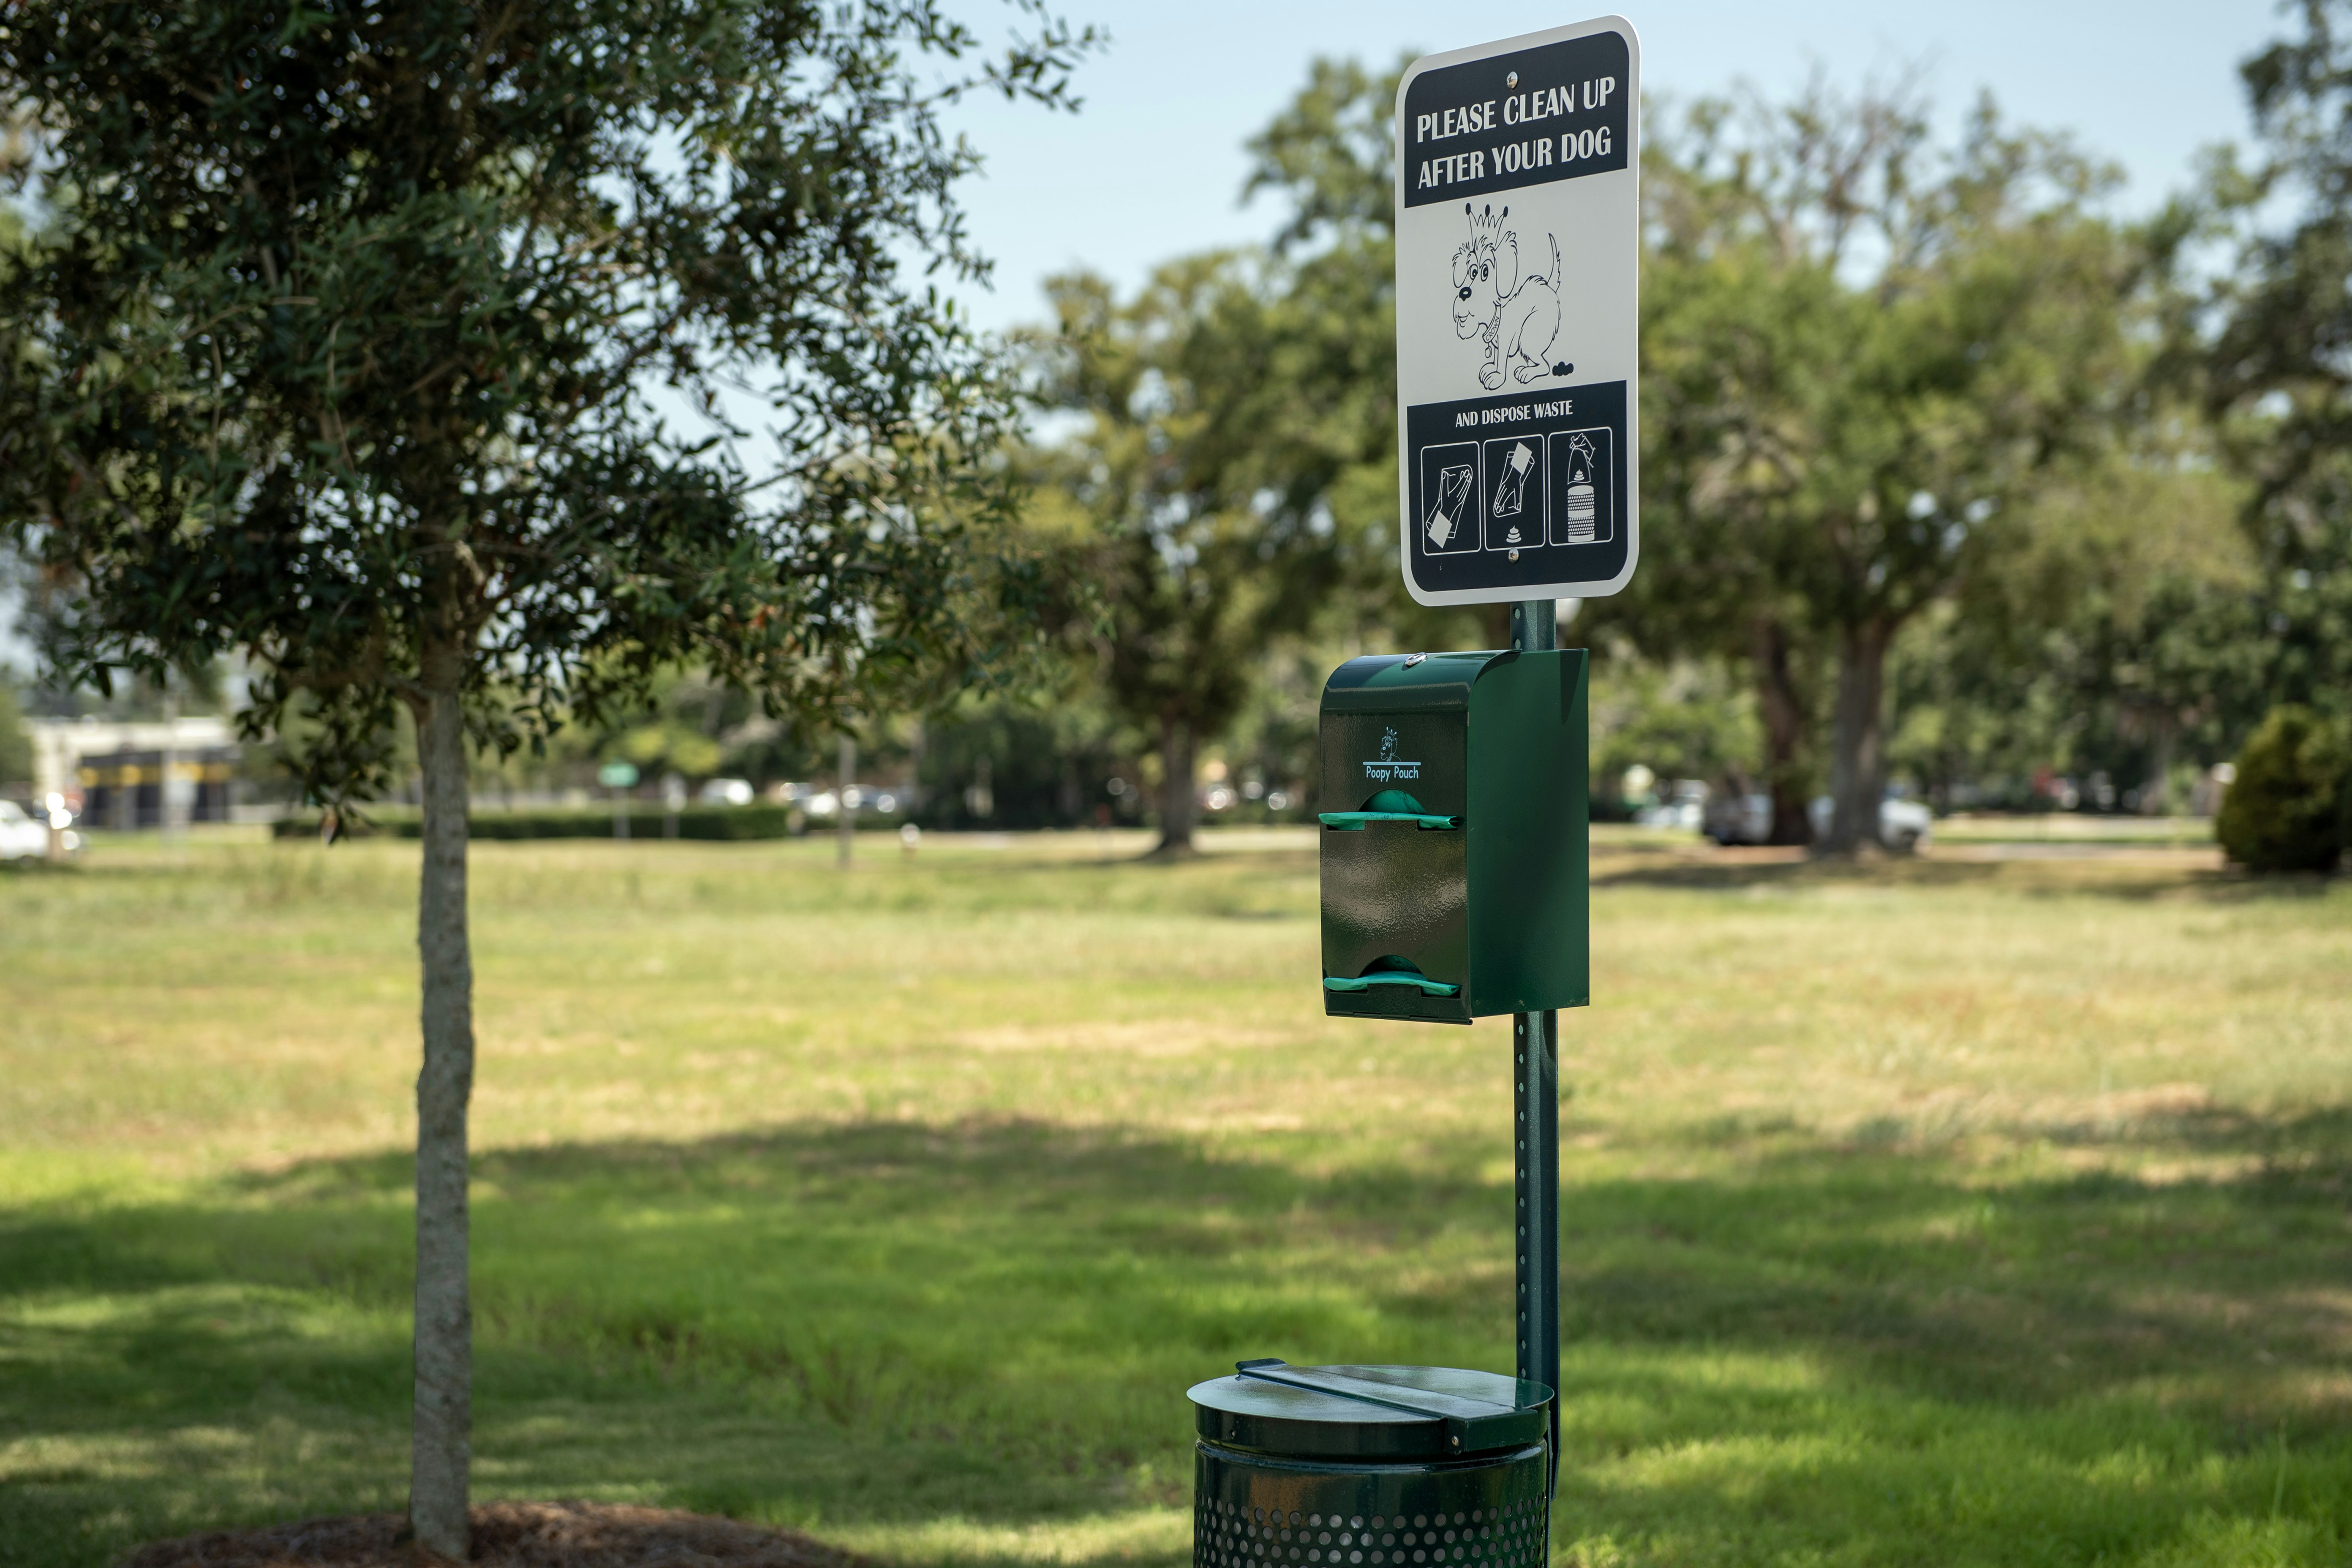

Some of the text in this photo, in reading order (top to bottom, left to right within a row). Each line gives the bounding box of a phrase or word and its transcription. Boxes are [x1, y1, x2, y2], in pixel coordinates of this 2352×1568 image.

[1417, 76, 1615, 143] PLEASE CLEAN UP
[1418, 126, 1611, 189] AFTER YOUR DOG
[1486, 316, 1500, 341] CROWN
[1456, 400, 1573, 427] AND DISPOSE WASTE
[1366, 765, 1418, 782] Poopy Pouch
